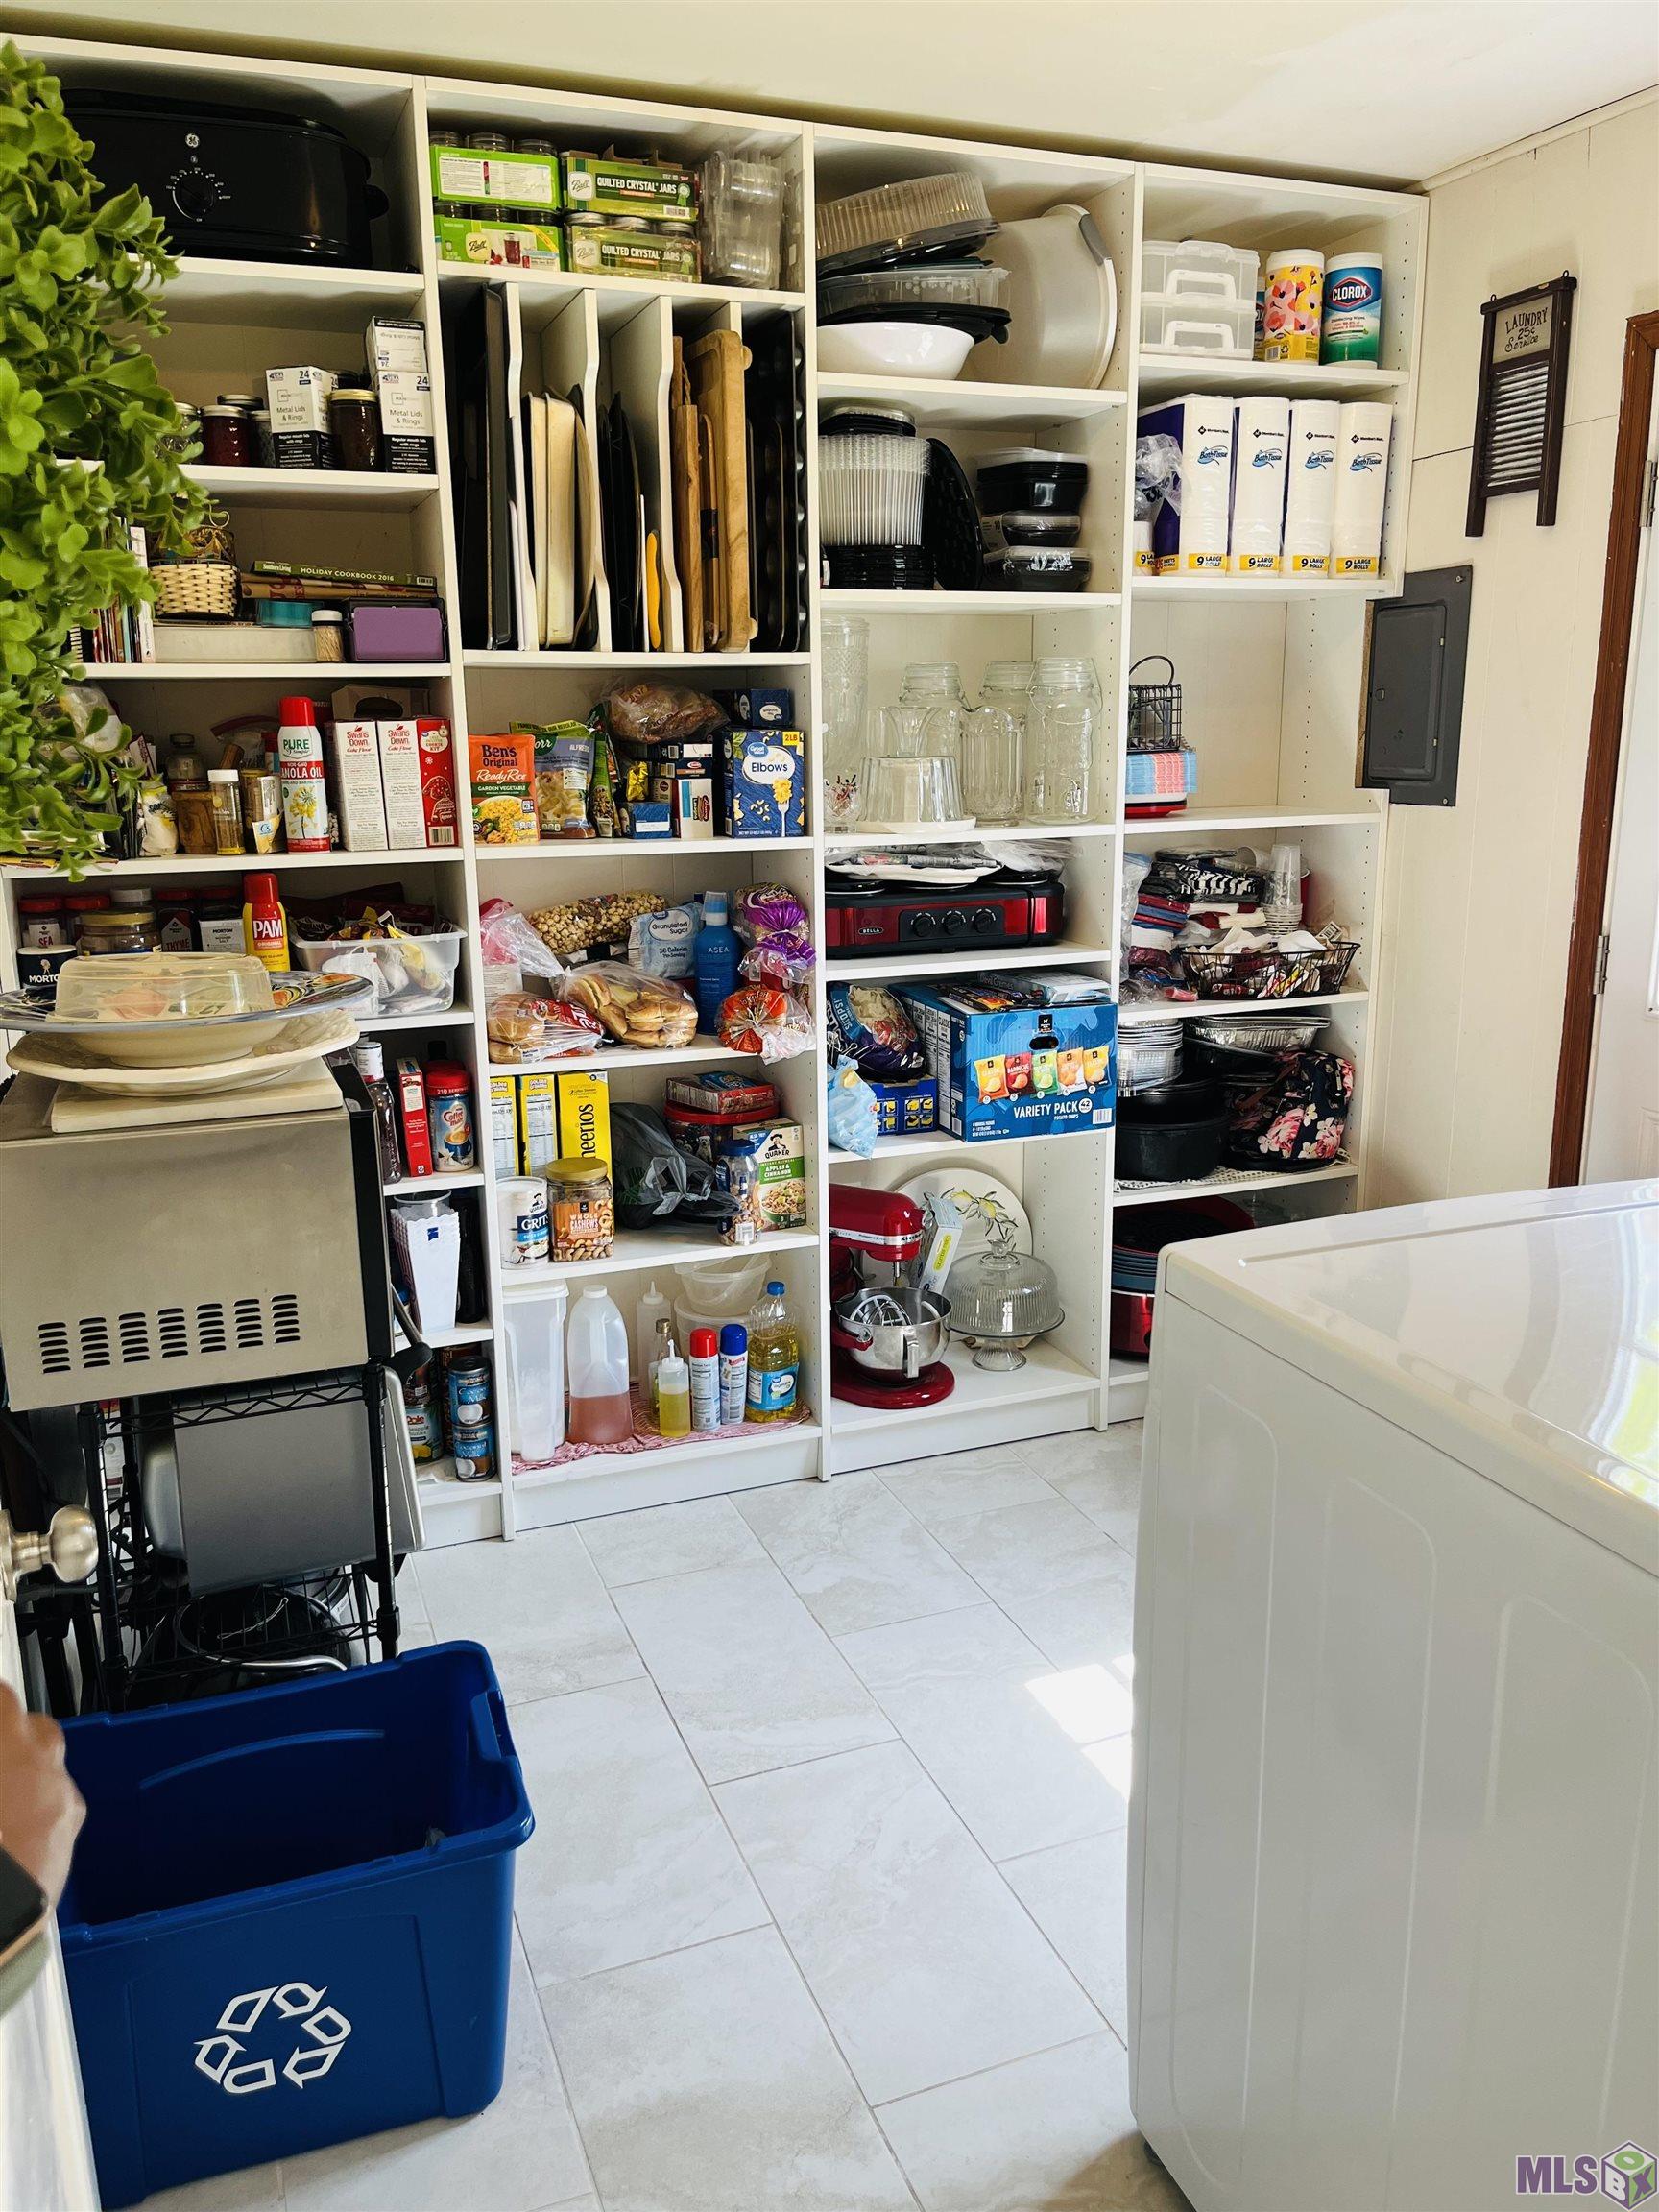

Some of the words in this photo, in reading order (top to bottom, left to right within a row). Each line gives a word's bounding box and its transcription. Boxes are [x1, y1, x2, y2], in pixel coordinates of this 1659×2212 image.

[597, 177, 625, 189] QUILTED
[659, 182, 677, 195] JARS
[602, 245, 630, 256] QUILTED
[662, 249, 681, 261] JARS
[1332, 285, 1367, 301] CLOROX
[1505, 307, 1549, 335] LAUNDRY
[1504, 335, 1539, 353] Service
[299, 370, 310, 379] 24
[417, 376, 428, 385] 24
[1199, 451, 1214, 460] Bath
[1141, 554, 1146, 565] 9
[1196, 556, 1204, 566] 9
[1248, 558, 1256, 567] 9
[1301, 558, 1309, 567] 9
[1345, 560, 1353, 569] 9
[301, 567, 333, 576] HOLIDAY
[334, 570, 377, 580] COOKBOOK
[347, 731, 370, 739] Swans
[784, 733, 799, 742] 2LB
[283, 739, 310, 750] PURE
[535, 739, 553, 749] orr
[481, 744, 517, 757] Ben's
[482, 757, 517, 768] Original
[751, 761, 788, 773] Elbows
[309, 766, 323, 778] OIL
[476, 769, 507, 784] Ready
[507, 769, 527, 781] Rice
[252, 919, 283, 939] PAM
[653, 922, 688, 930] Granulated
[38, 936, 54, 946] SEA
[29, 974, 60, 983] MORTO
[1014, 1104, 1051, 1118] VARIETY
[1054, 1100, 1078, 1114] PACK
[579, 1103, 596, 1158] eerios
[765, 1150, 790, 1159] QUAKER
[764, 1168, 792, 1178] CINNAMON
[765, 1164, 785, 1172] APPLES
[569, 1219, 599, 1229] CASHEWS
